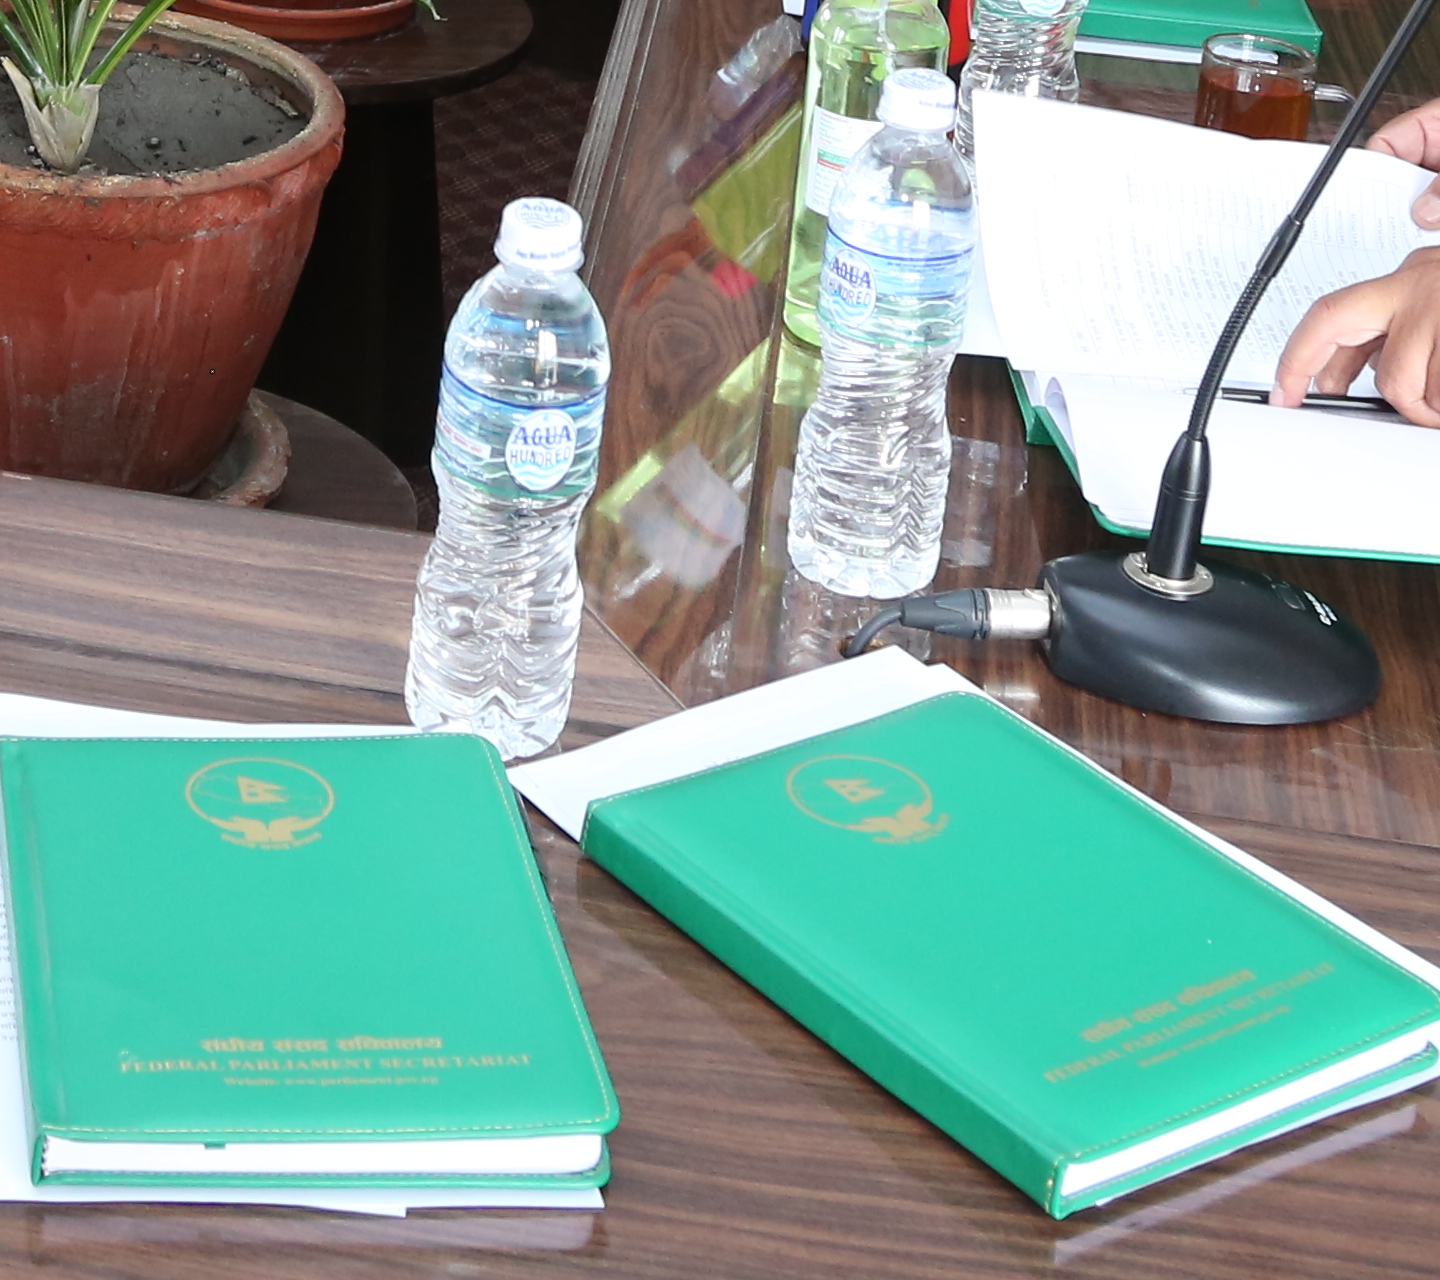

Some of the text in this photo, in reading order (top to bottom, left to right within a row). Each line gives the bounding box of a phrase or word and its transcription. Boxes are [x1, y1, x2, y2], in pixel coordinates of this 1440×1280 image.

[830, 257, 873, 289] AQUA
[511, 425, 573, 450] AQUA
[510, 446, 571, 467] HUNDRED
[121, 1053, 531, 1073] FEDERAL PARLIAMENT SECRETARIAT
